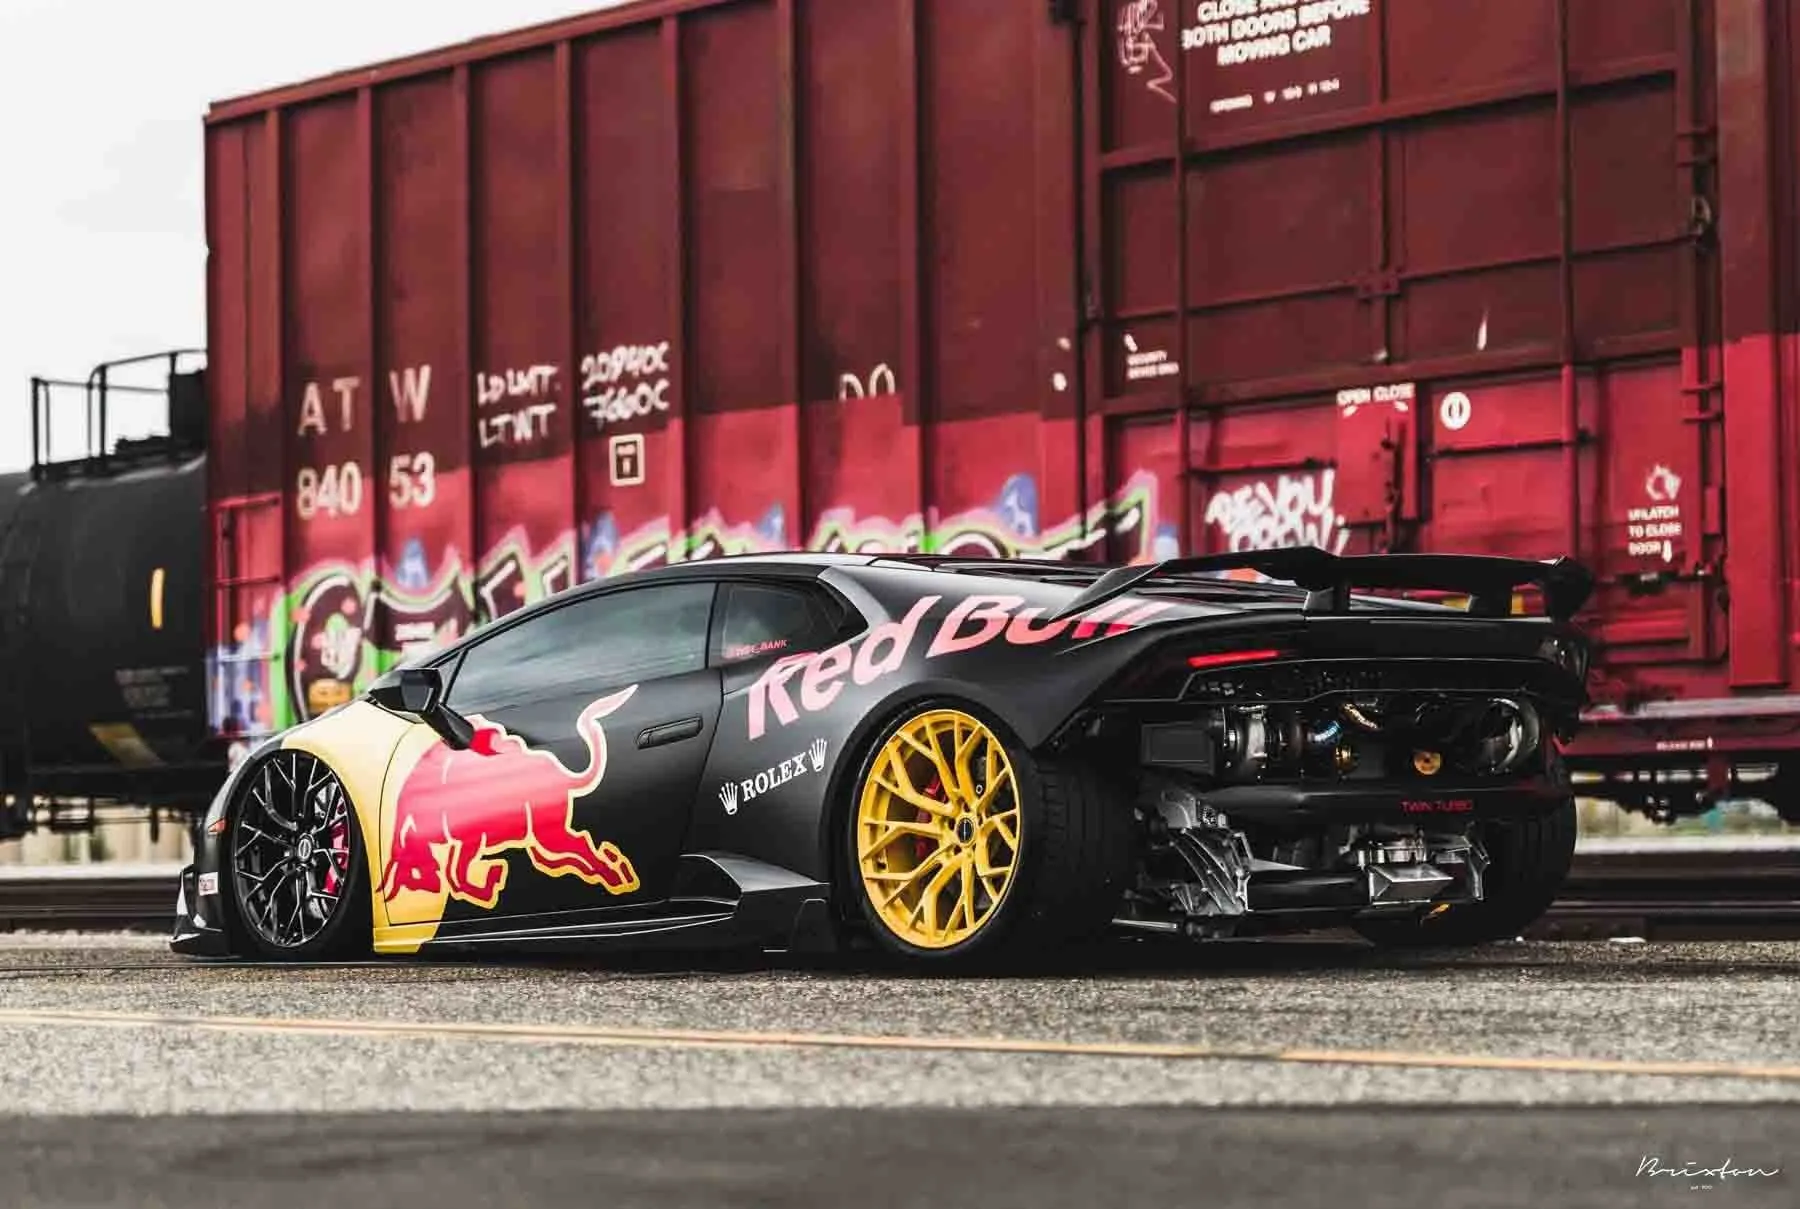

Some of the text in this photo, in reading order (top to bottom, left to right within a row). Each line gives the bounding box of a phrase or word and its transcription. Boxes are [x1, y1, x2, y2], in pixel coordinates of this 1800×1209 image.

[1217, 25, 1331, 65] MOVING CAR
[1231, 10, 1296, 39] DOORS
[748, 594, 1176, 741] Red Bull
[741, 751, 808, 802] ROLEX
